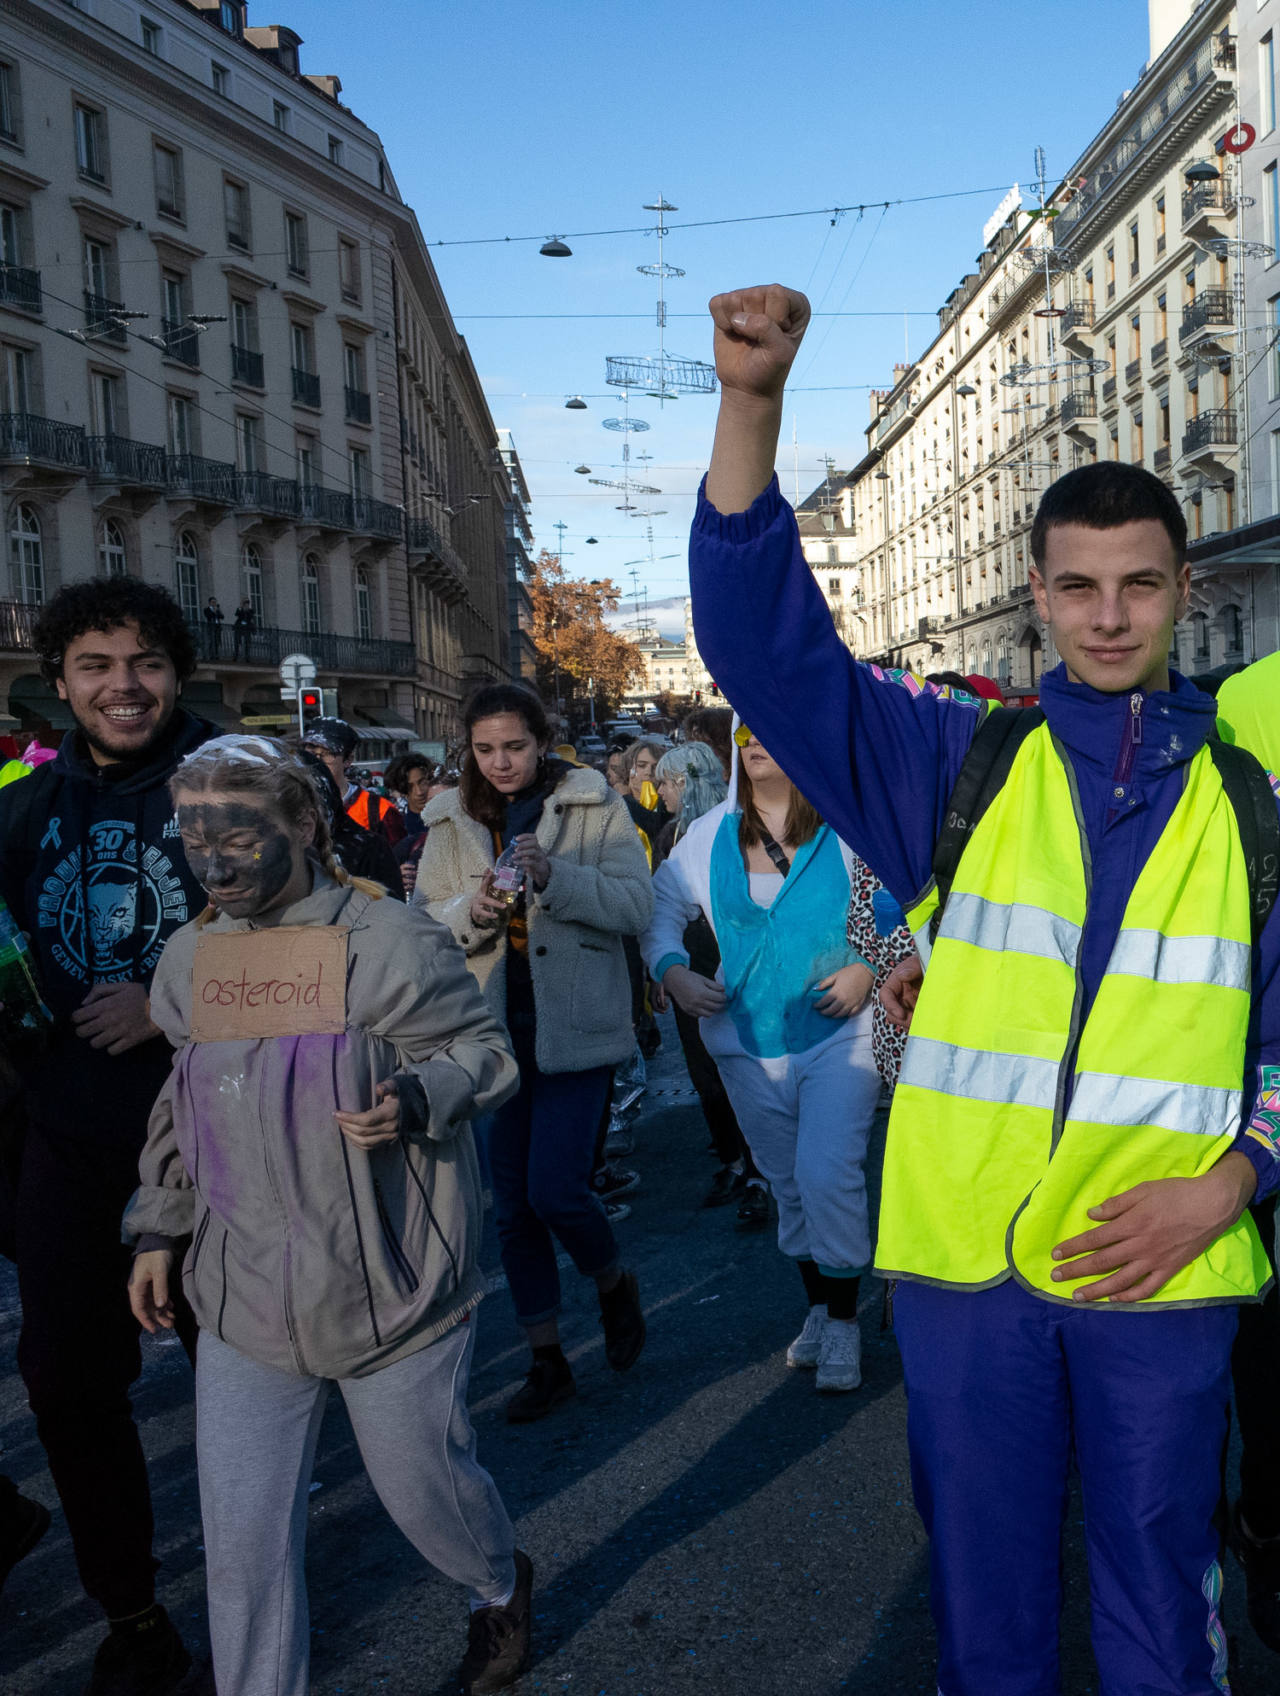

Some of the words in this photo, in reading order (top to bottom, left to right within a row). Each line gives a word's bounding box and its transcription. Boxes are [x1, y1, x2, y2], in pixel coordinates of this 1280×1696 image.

[93, 830, 124, 851] 30
[97, 851, 117, 860] ans
[51, 944, 90, 984] GENEV
[202, 960, 323, 1012] asteroid
